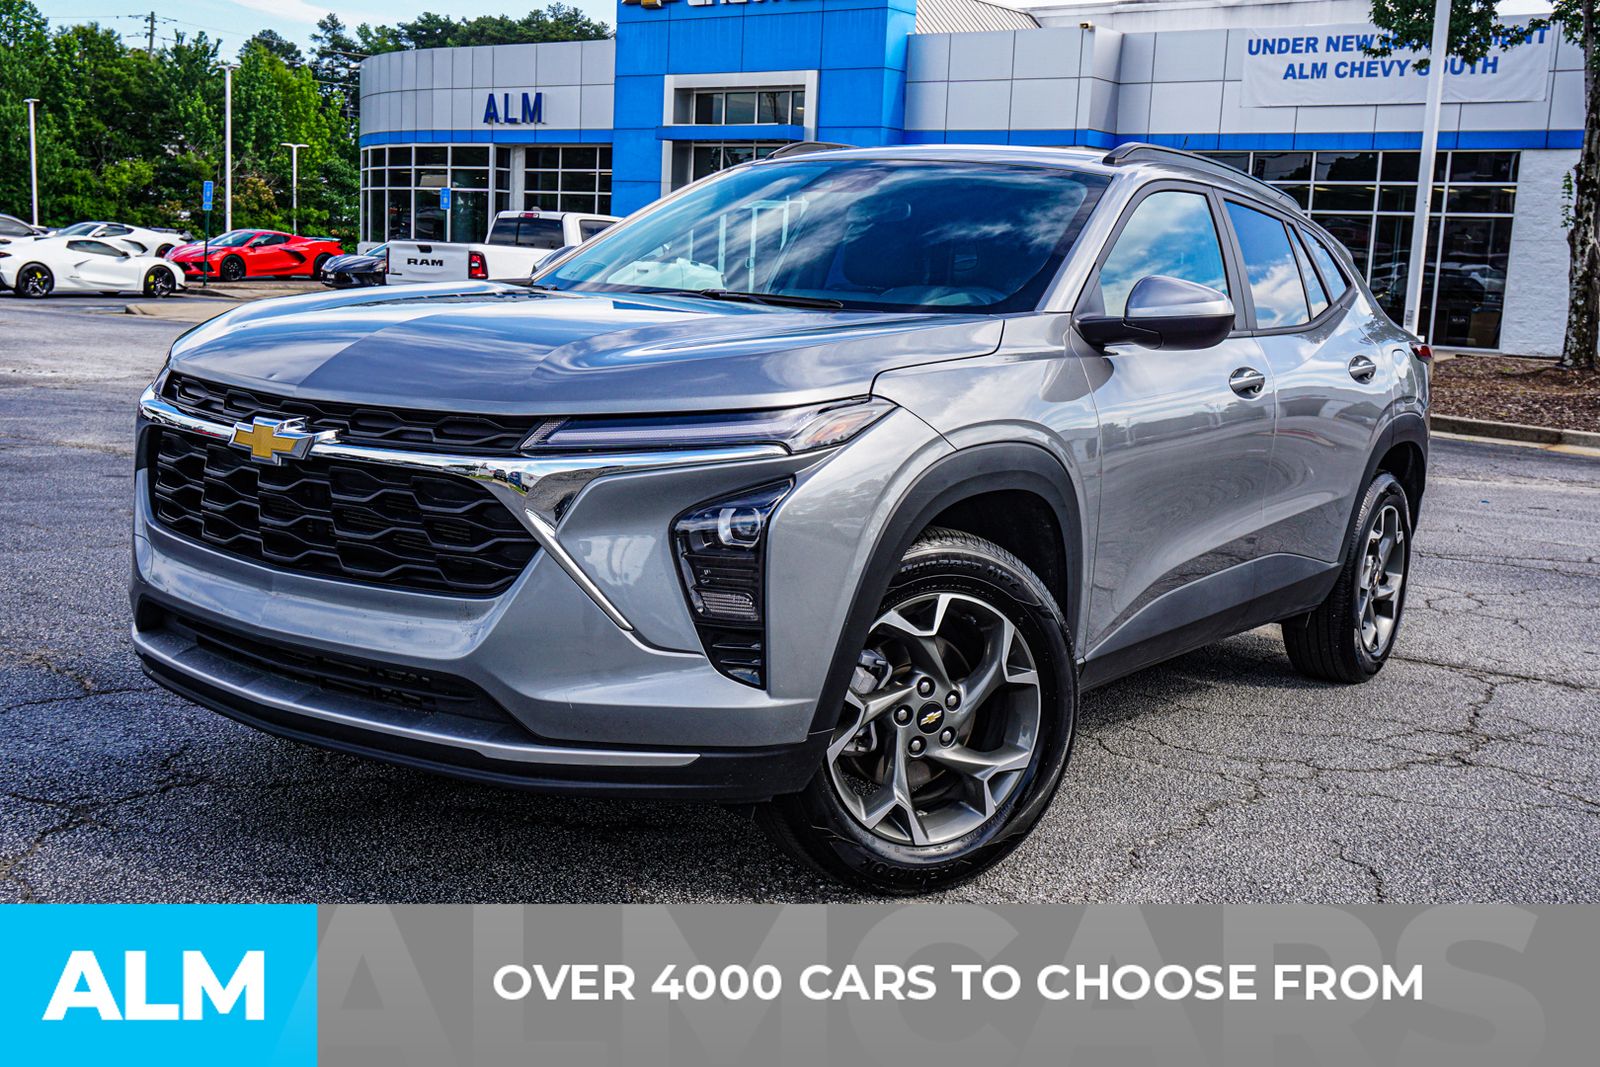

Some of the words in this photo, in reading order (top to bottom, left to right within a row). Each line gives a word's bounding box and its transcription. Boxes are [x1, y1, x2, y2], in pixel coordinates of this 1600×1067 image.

[1247, 36, 1318, 56] UNDER
[1325, 34, 1376, 53] NEW
[1283, 61, 1328, 80] ALM
[1334, 59, 1412, 79] CHEVY
[1417, 56, 1499, 76] UTH
[483, 92, 543, 124] ALM
[407, 258, 444, 267] RAM
